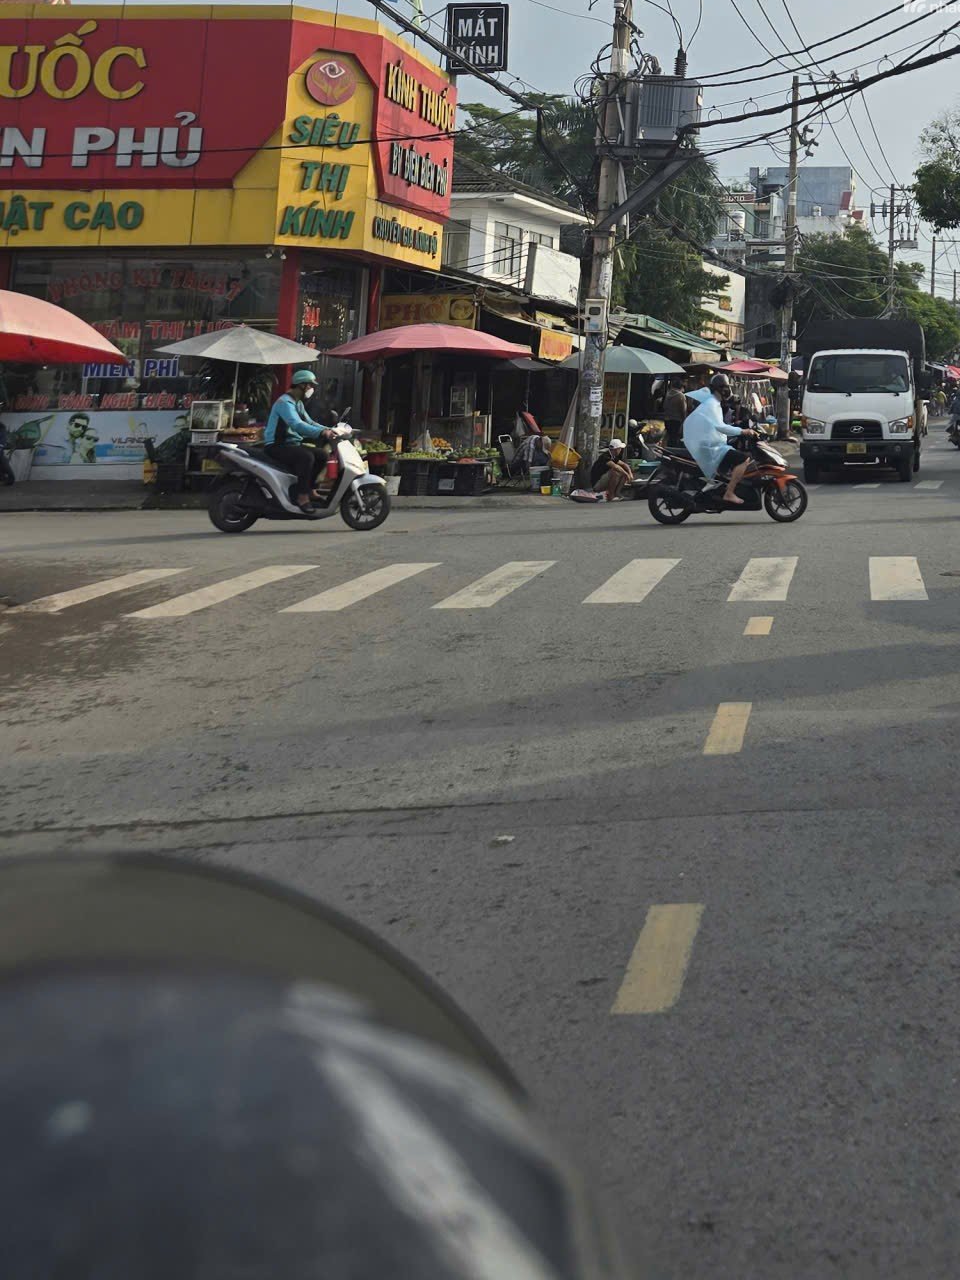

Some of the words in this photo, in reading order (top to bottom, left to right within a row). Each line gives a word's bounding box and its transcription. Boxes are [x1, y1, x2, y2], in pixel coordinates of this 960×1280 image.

[457, 10, 498, 37] MẮT
[455, 41, 499, 65] KÍNH
[385, 60, 418, 112] KÍNH
[420, 87, 456, 132] THUỐC
[0, 127, 46, 167] N
[71, 111, 203, 168] PHỦ
[290, 113, 361, 150] SIÊU
[301, 161, 350, 201] THỊ
[0, 195, 54, 236] ẬT
[63, 200, 145, 231] CAO
[279, 200, 355, 240] KÍNH
[145, 321, 184, 340] THỊ
[144, 354, 181, 378] PHÍ
